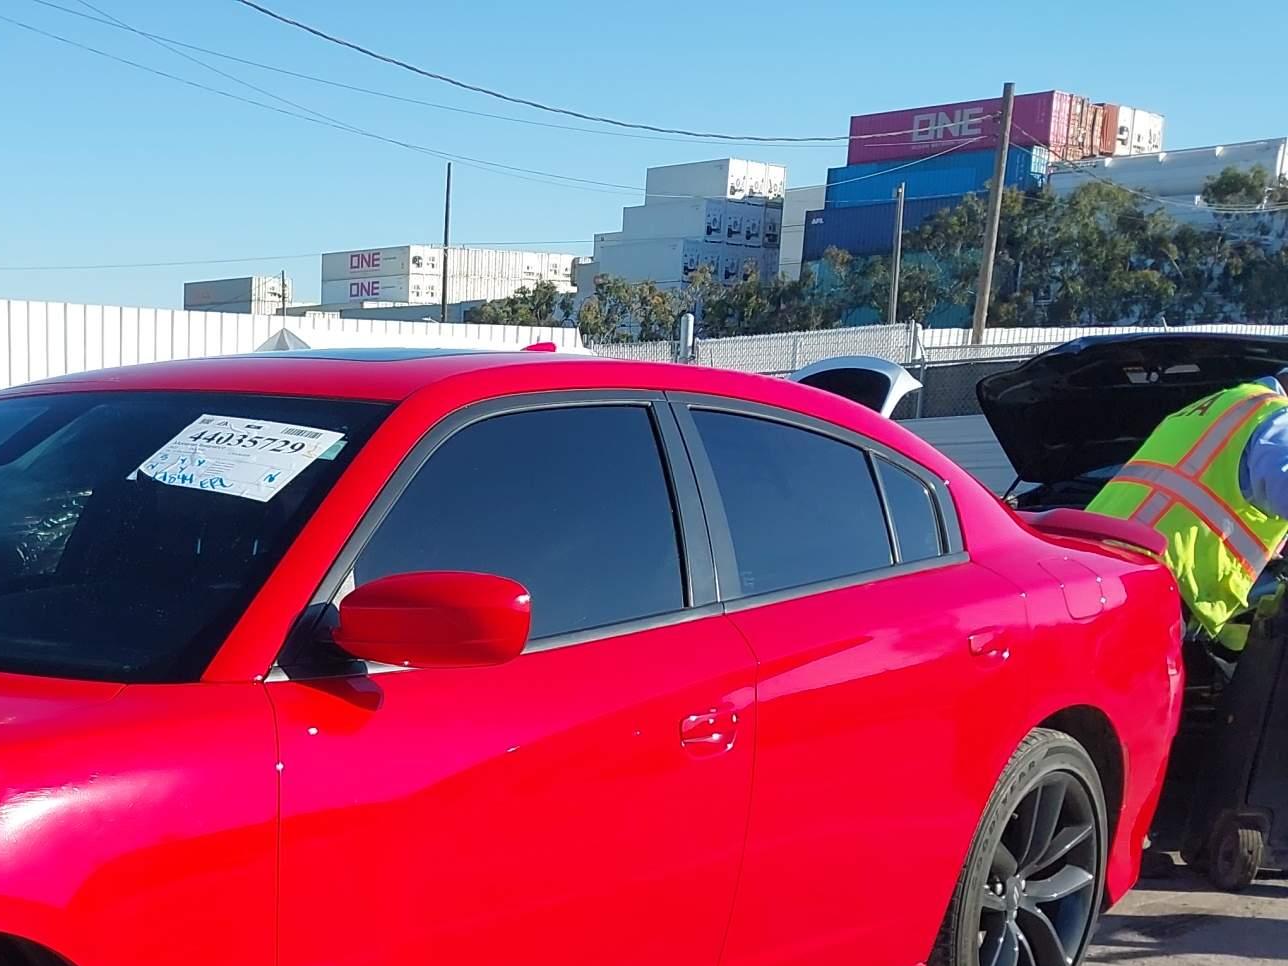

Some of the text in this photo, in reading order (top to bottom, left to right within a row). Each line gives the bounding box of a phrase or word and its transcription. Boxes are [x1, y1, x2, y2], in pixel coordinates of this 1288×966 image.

[913, 107, 983, 141] ONE
[350, 252, 380, 269] ONE
[350, 281, 380, 297] ONE
[189, 429, 306, 455] 44035729
